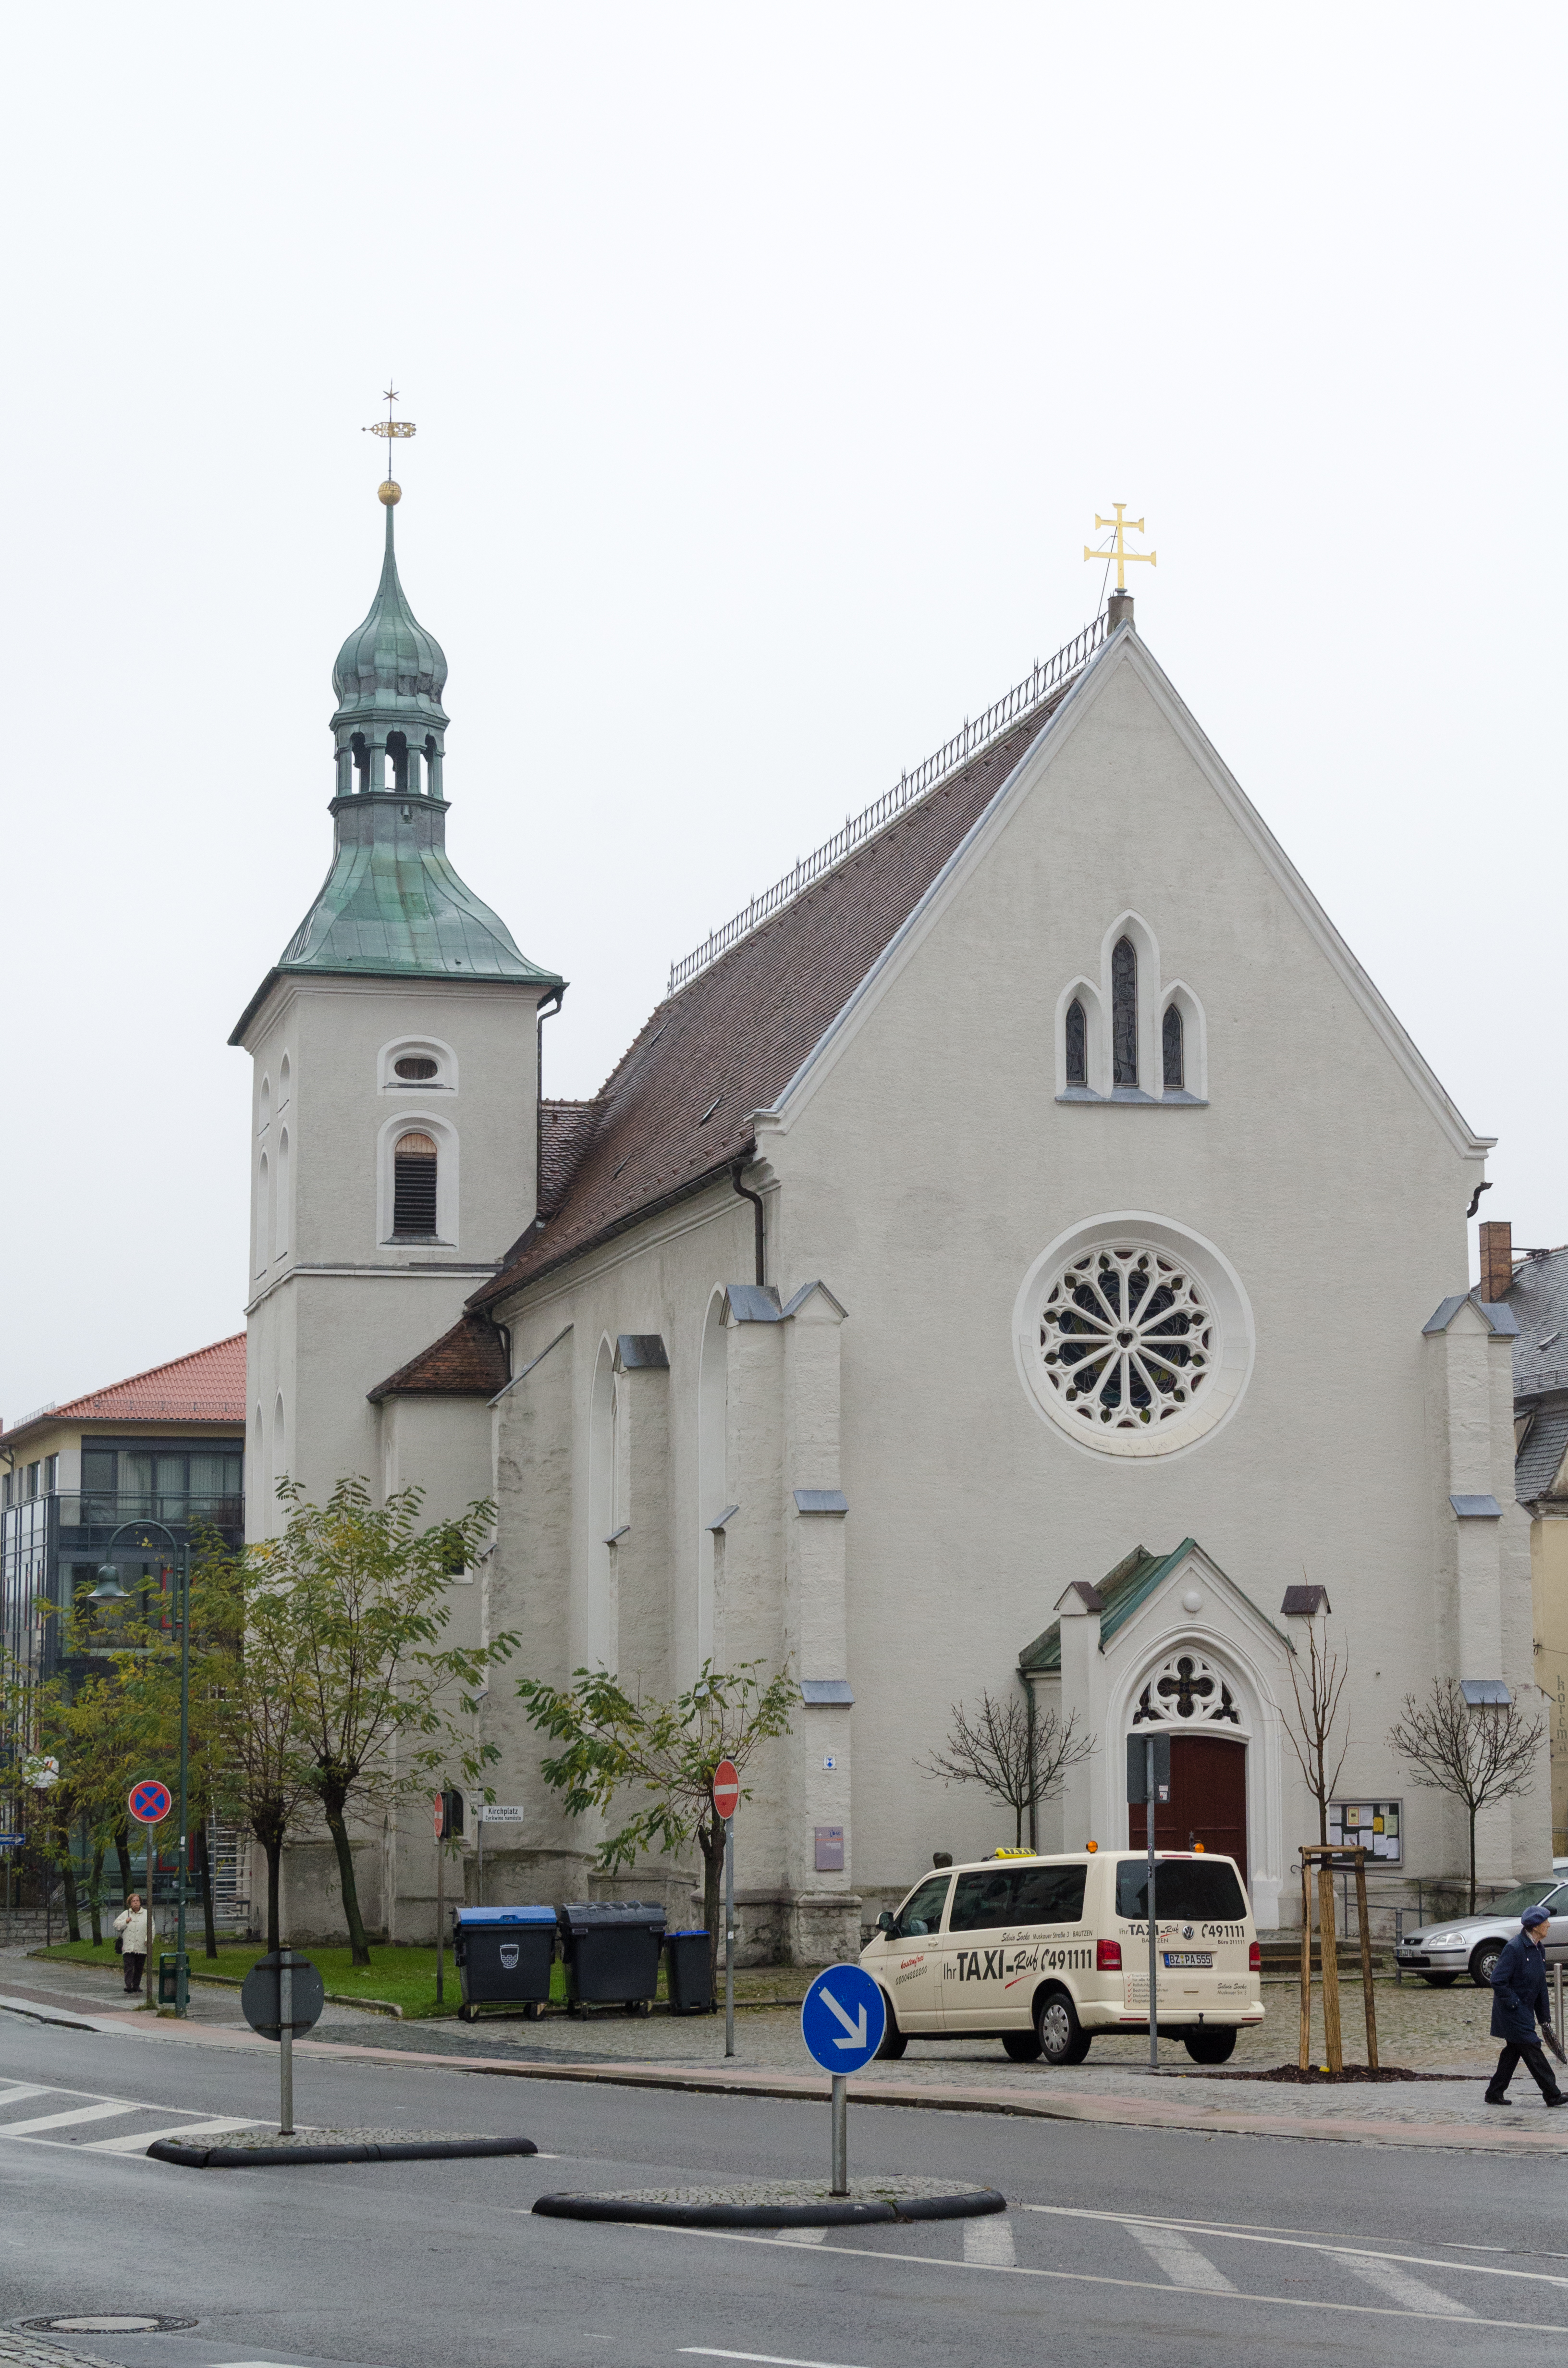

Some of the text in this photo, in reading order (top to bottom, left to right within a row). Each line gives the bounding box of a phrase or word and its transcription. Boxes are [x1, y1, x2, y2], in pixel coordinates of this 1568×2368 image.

[488, 1807, 518, 1816] Kirchplatz
[1208, 1925, 1245, 1937] 491111
[1001, 1933, 1015, 1942] Silvio
[1016, 1932, 1030, 1941] Socke
[1048, 1949, 1092, 1970] 491111
[1169, 1955, 1211, 1964] BZ PA 555
